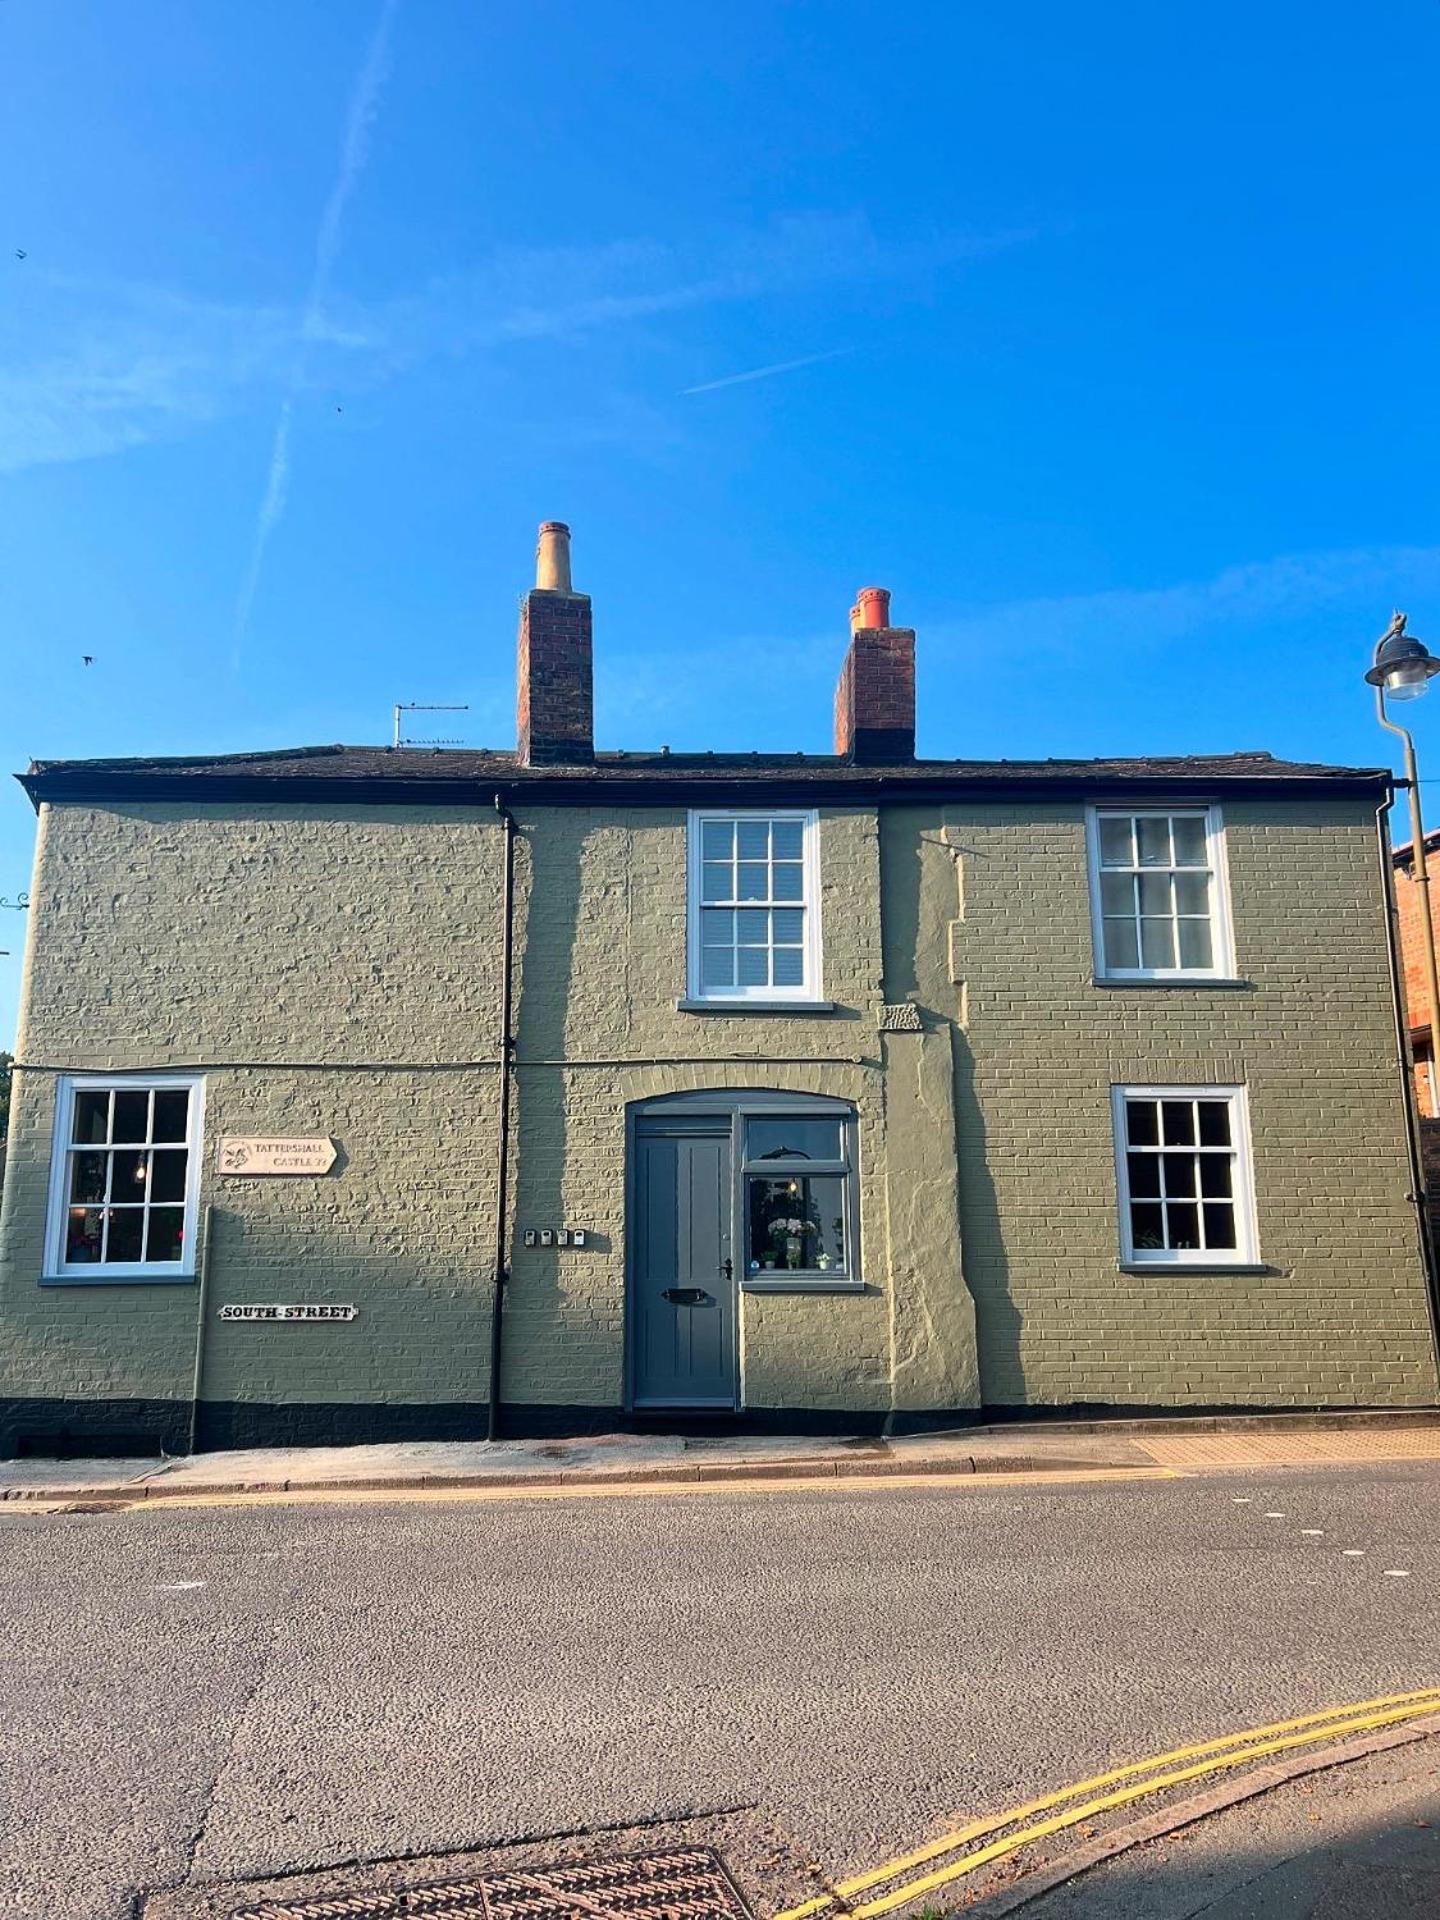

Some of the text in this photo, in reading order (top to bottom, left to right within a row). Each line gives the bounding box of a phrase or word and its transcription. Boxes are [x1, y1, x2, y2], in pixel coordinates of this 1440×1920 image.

[254, 1143, 325, 1153] TATTERSHALL
[273, 1157, 313, 1167] CASTLE
[223, 1306, 352, 1318] SOUTH STREET
